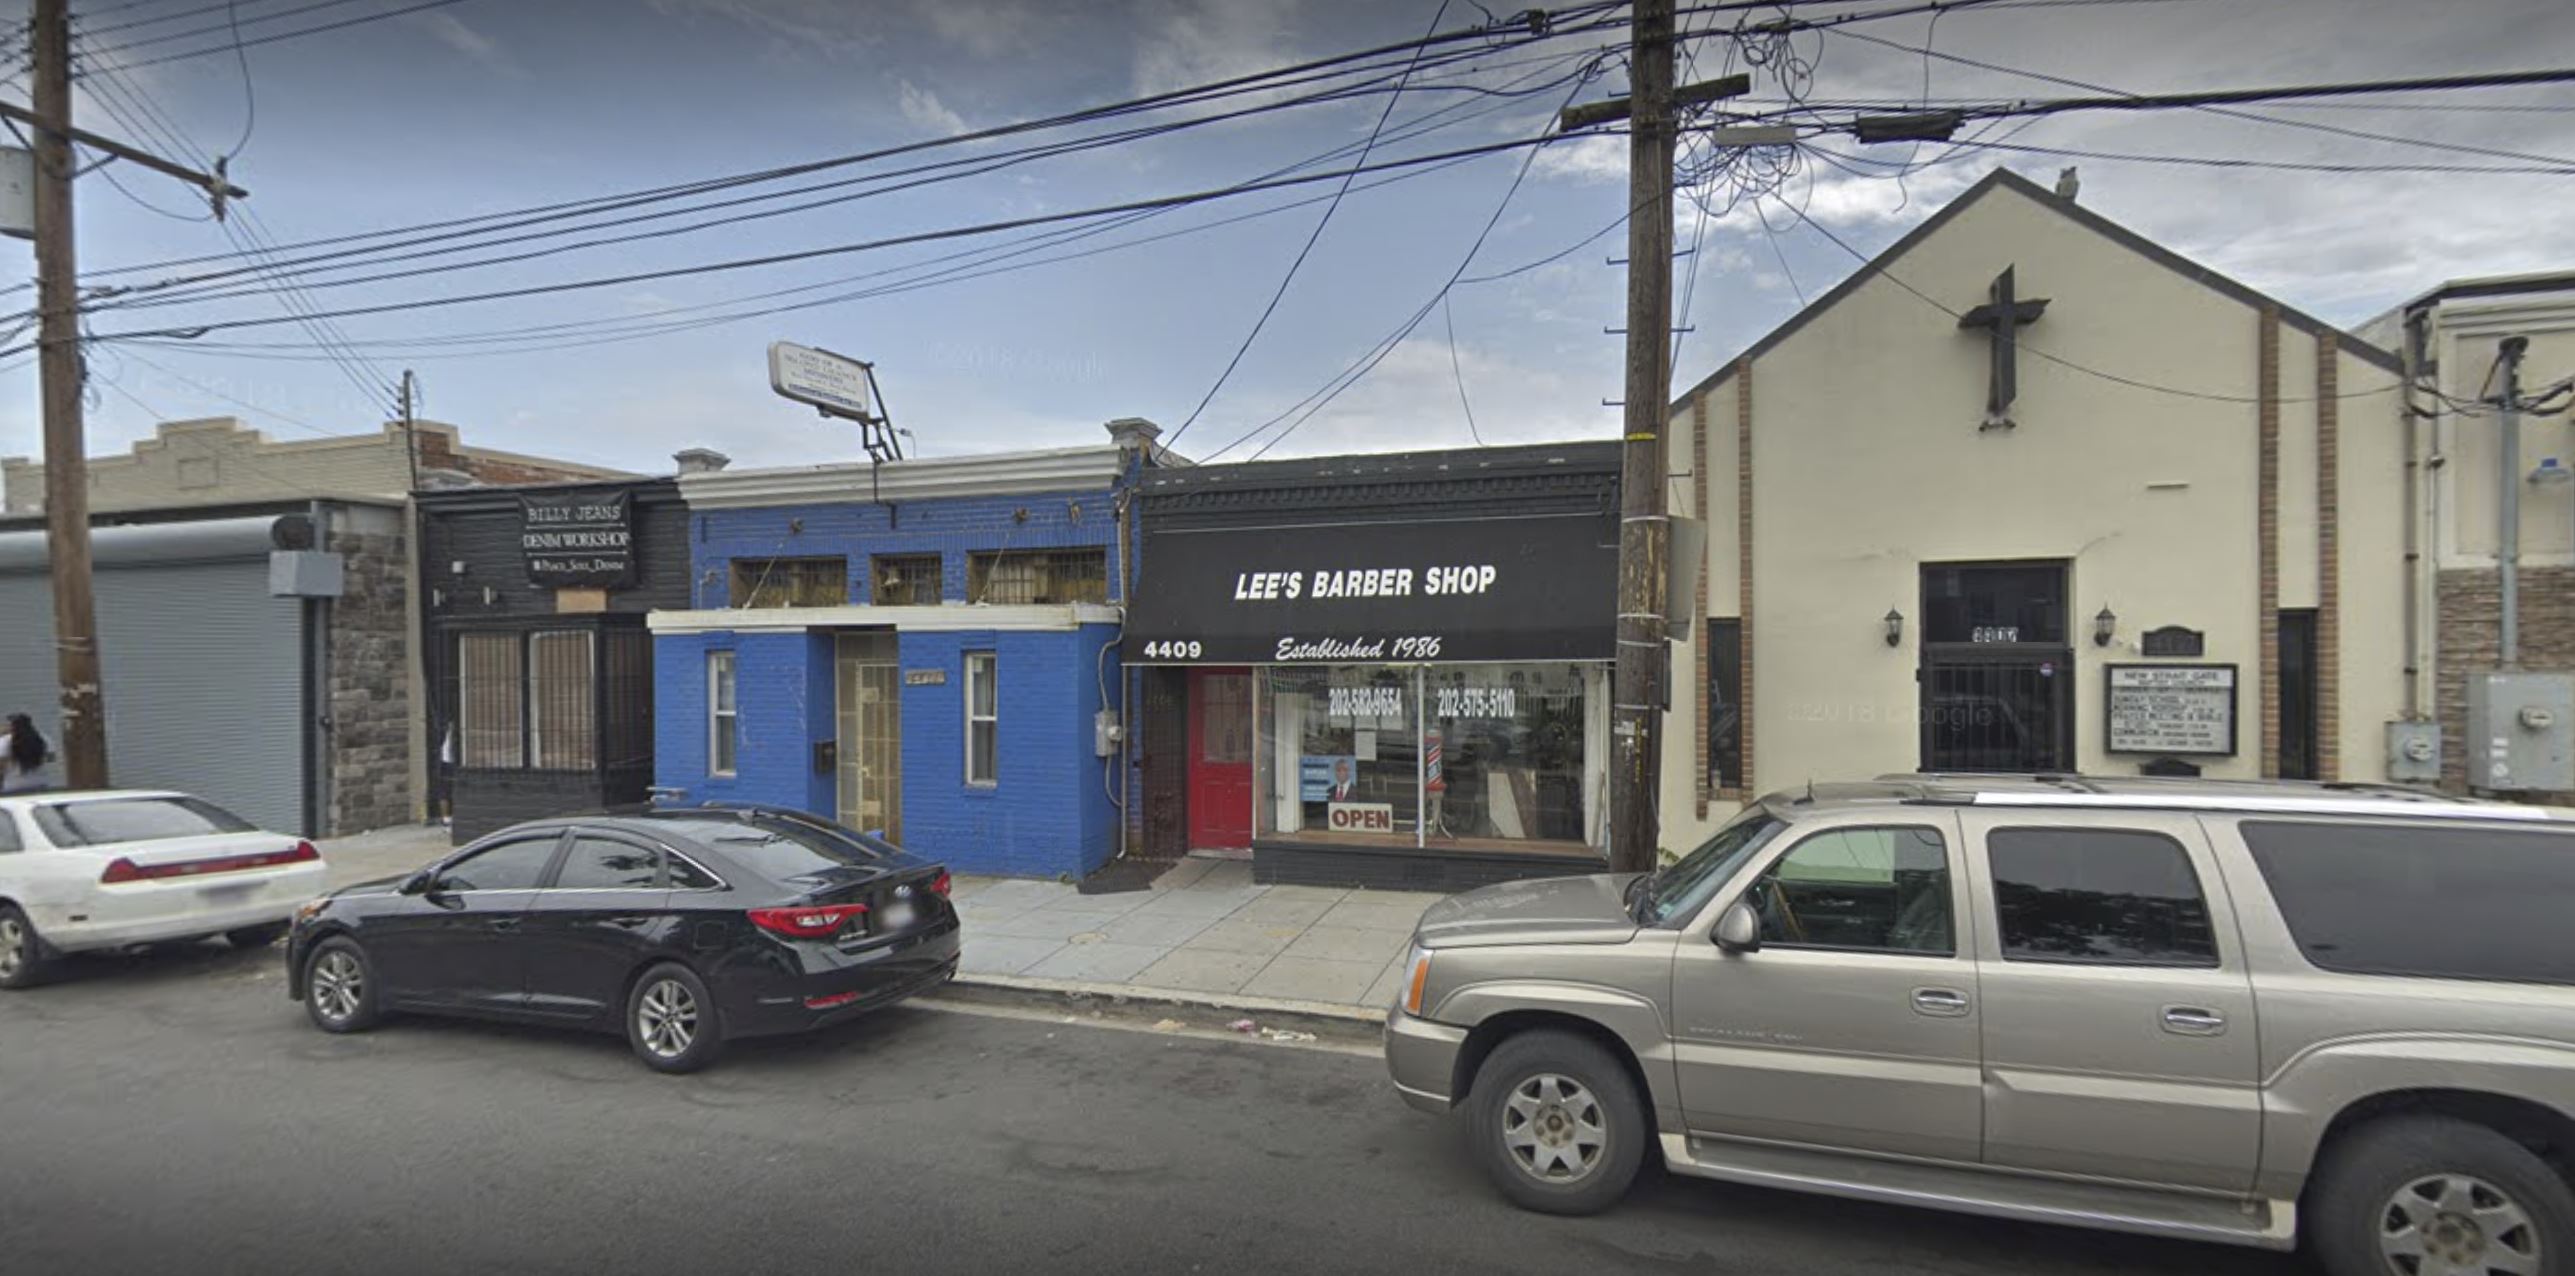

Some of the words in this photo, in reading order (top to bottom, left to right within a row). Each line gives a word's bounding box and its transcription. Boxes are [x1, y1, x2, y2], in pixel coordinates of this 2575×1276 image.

[528, 507, 571, 522] BILLY
[575, 505, 622, 521] JEANS
[523, 533, 561, 548] DENIM
[563, 532, 630, 547] WORKSHOP
[1235, 571, 1303, 600] LEE'S
[1312, 568, 1413, 598] BARBER
[1425, 565, 1496, 595] SHOP
[1144, 640, 1202, 658] 4409
[1275, 636, 1385, 661] Established
[1391, 636, 1443, 659] 1986
[1328, 687, 1402, 717] 202-582-9654
[1437, 688, 1516, 718] 202-575-5110
[1332, 809, 1390, 829] OPEN
